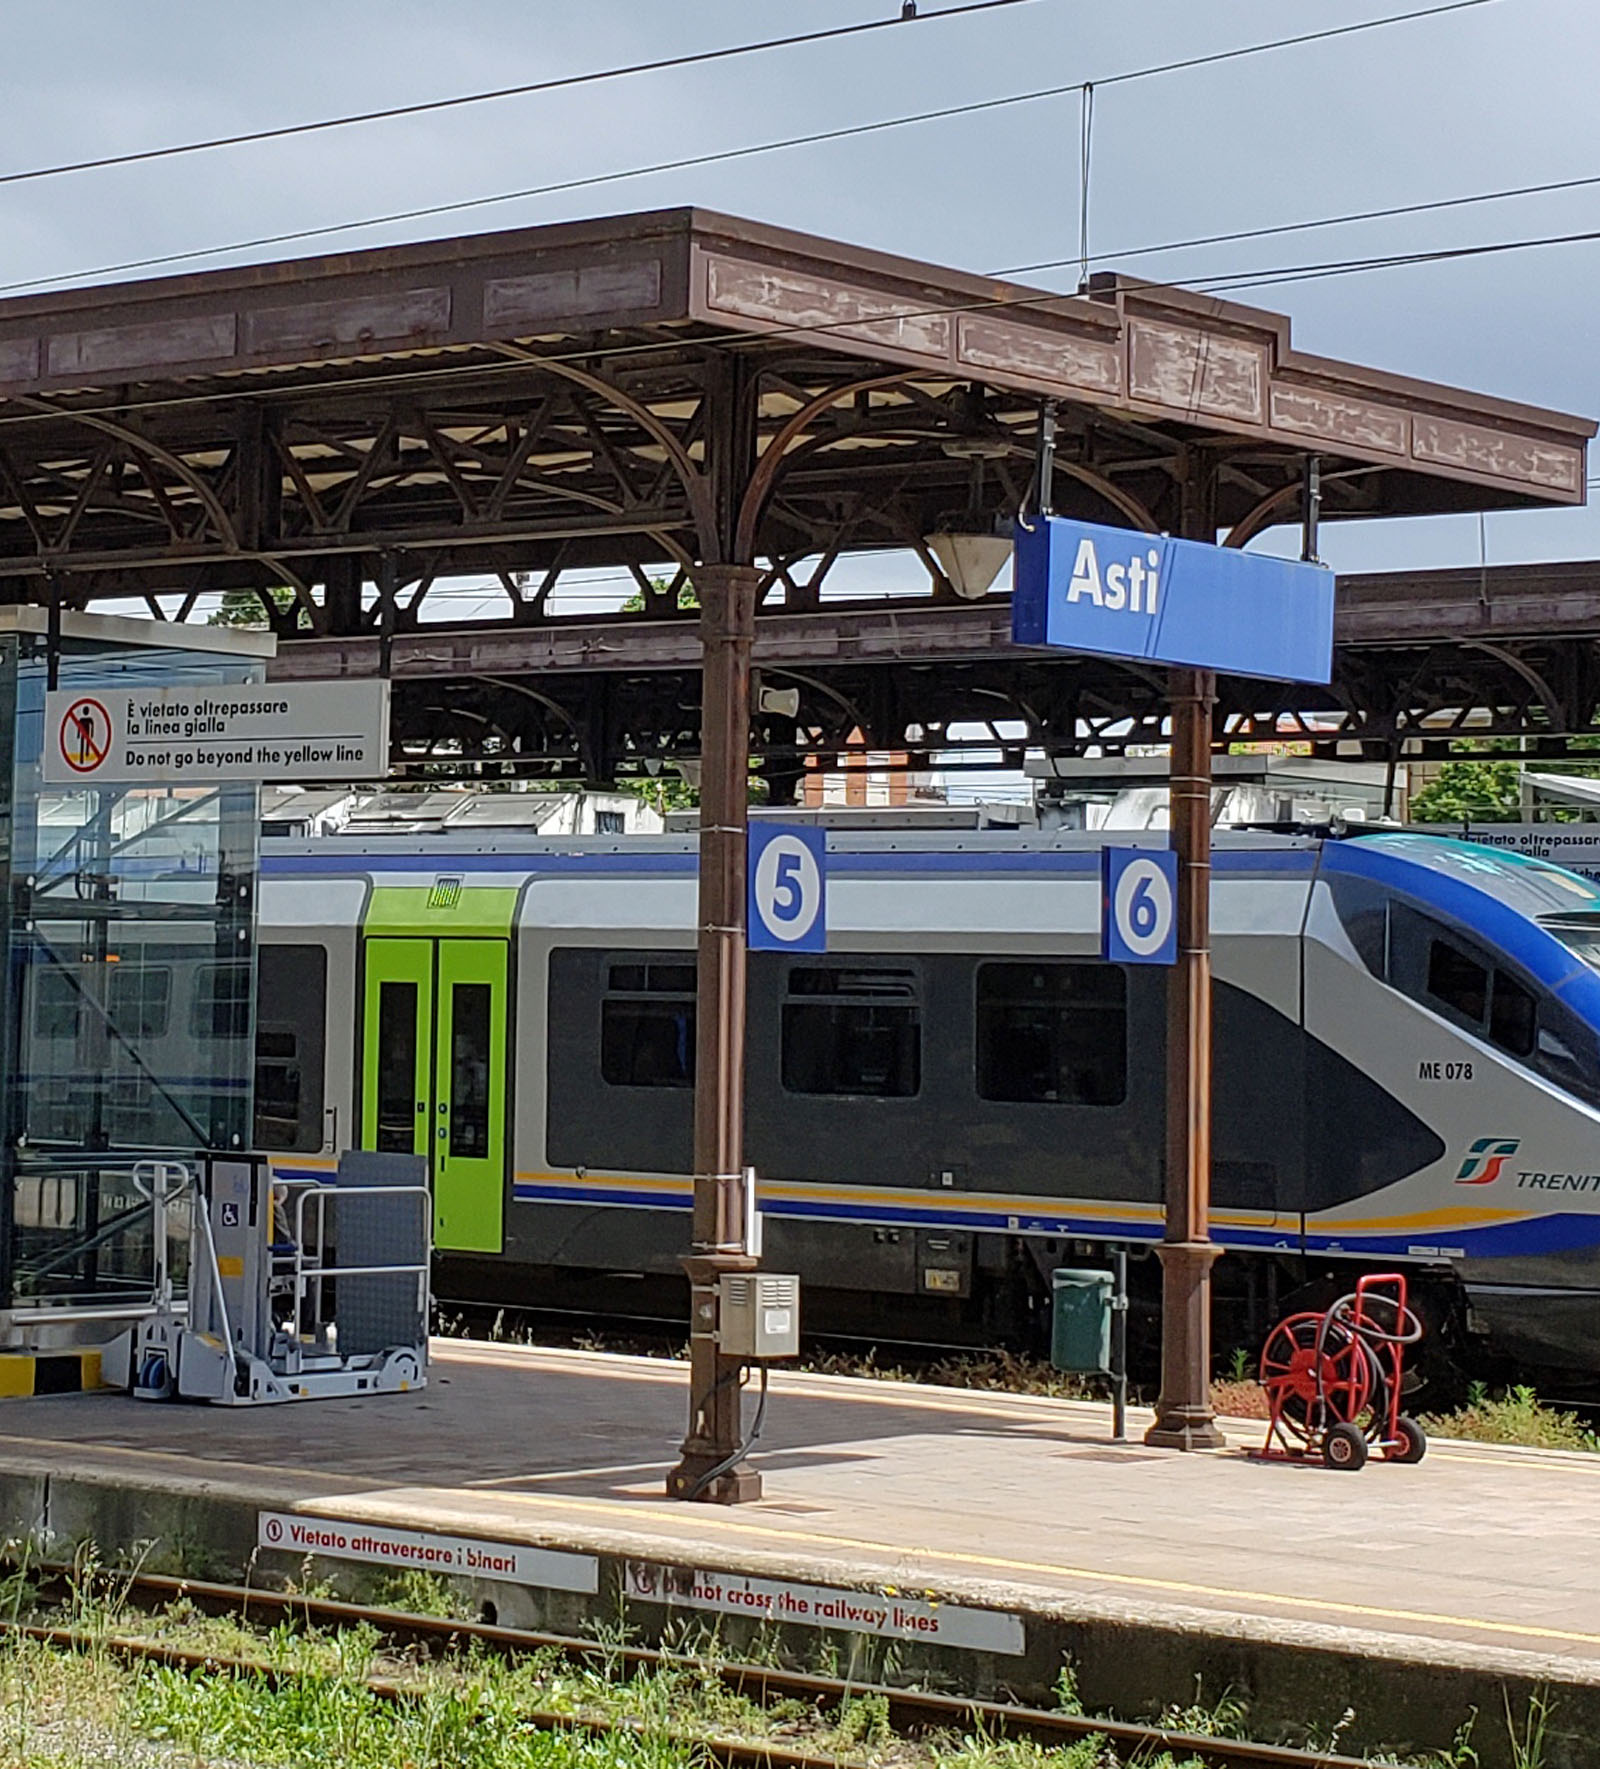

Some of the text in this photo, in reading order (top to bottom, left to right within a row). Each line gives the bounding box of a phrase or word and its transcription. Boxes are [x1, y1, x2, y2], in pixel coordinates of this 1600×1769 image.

[1066, 539, 1159, 615] Asti
[126, 718, 225, 738] la linea gialla
[140, 701, 189, 717] vietato
[194, 700, 288, 718] oltrepassare
[126, 746, 363, 769] Do not go beyond the yellow line
[772, 853, 803, 922] 5
[1129, 877, 1157, 938] 6
[1419, 1062, 1473, 1080] ME 078
[290, 1524, 516, 1573] Vietato attraversare i binari
[693, 1585, 722, 1601] not
[727, 1589, 772, 1609] cross
[778, 1591, 808, 1613] the
[814, 1600, 887, 1629] railway
[893, 1607, 938, 1633] lines
